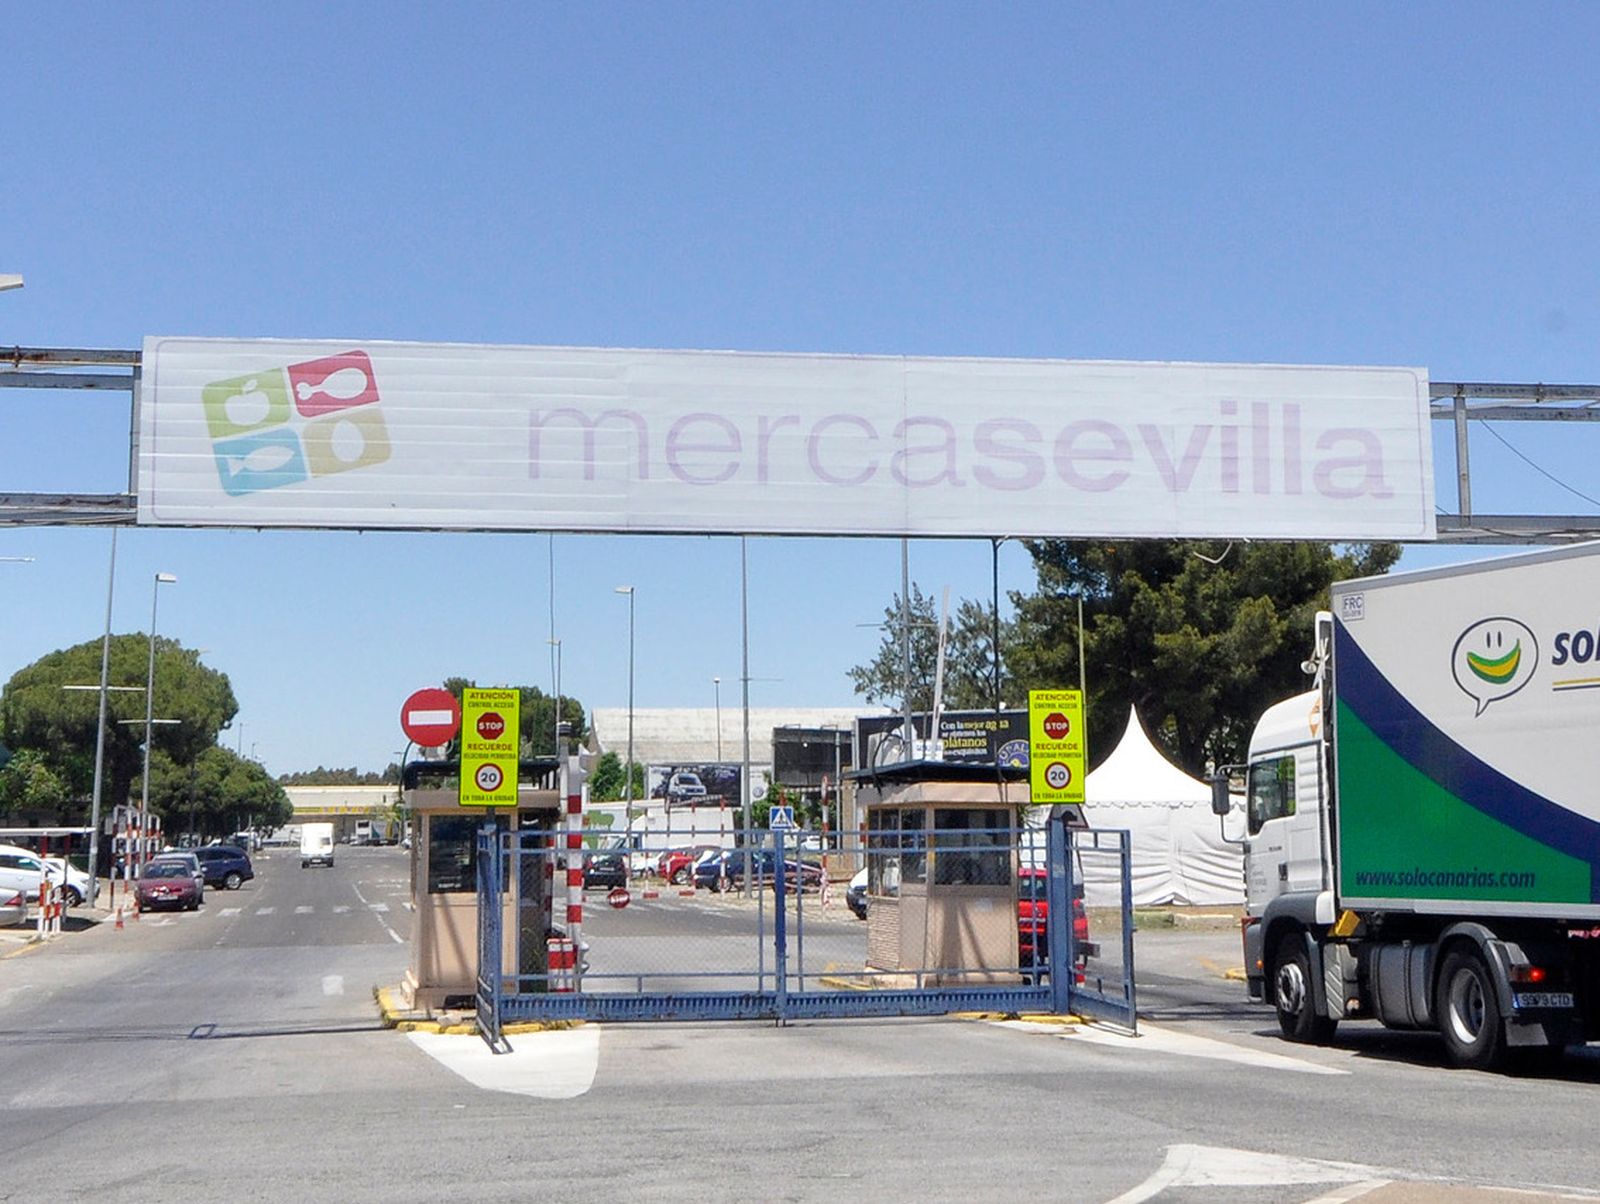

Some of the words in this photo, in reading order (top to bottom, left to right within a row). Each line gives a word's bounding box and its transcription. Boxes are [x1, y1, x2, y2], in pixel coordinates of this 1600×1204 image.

[528, 400, 1394, 500] mercasevilla
[1343, 596, 1362, 609] FRC
[1035, 692, 1076, 701] ATENCIÓN
[478, 722, 503, 730] STOP
[941, 721, 955, 730] Con
[1045, 722, 1068, 730] STOP
[467, 743, 512, 751] RECUERDE
[480, 772, 497, 783] 20
[1050, 771, 1066, 781] 20
[1355, 867, 1536, 888] www.solocanarias.com
